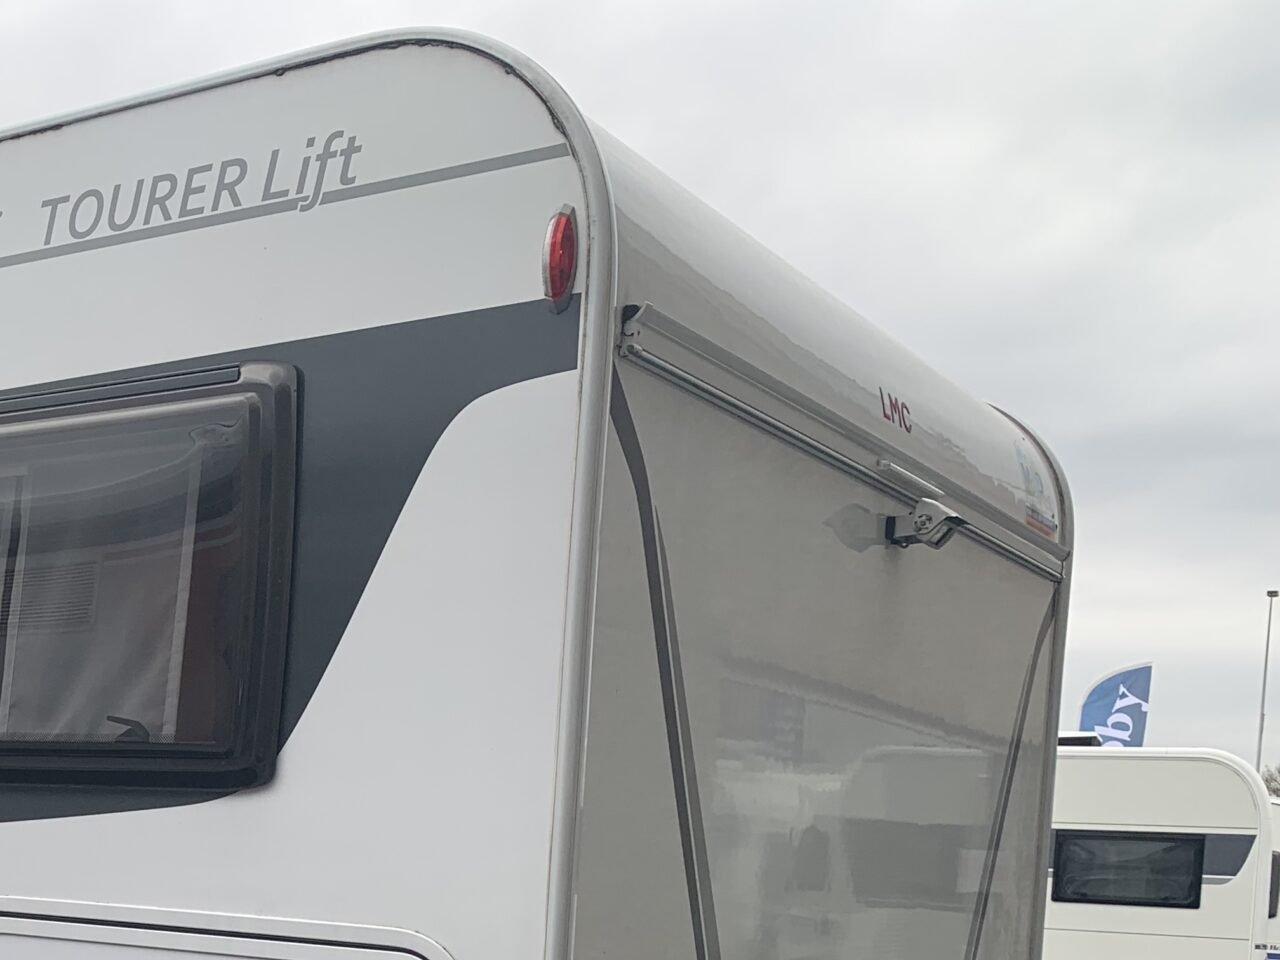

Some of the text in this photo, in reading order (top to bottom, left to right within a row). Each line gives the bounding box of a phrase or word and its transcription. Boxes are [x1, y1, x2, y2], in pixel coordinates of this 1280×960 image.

[41, 130, 363, 246] TOURER Lift
[879, 386, 912, 434] LMC
